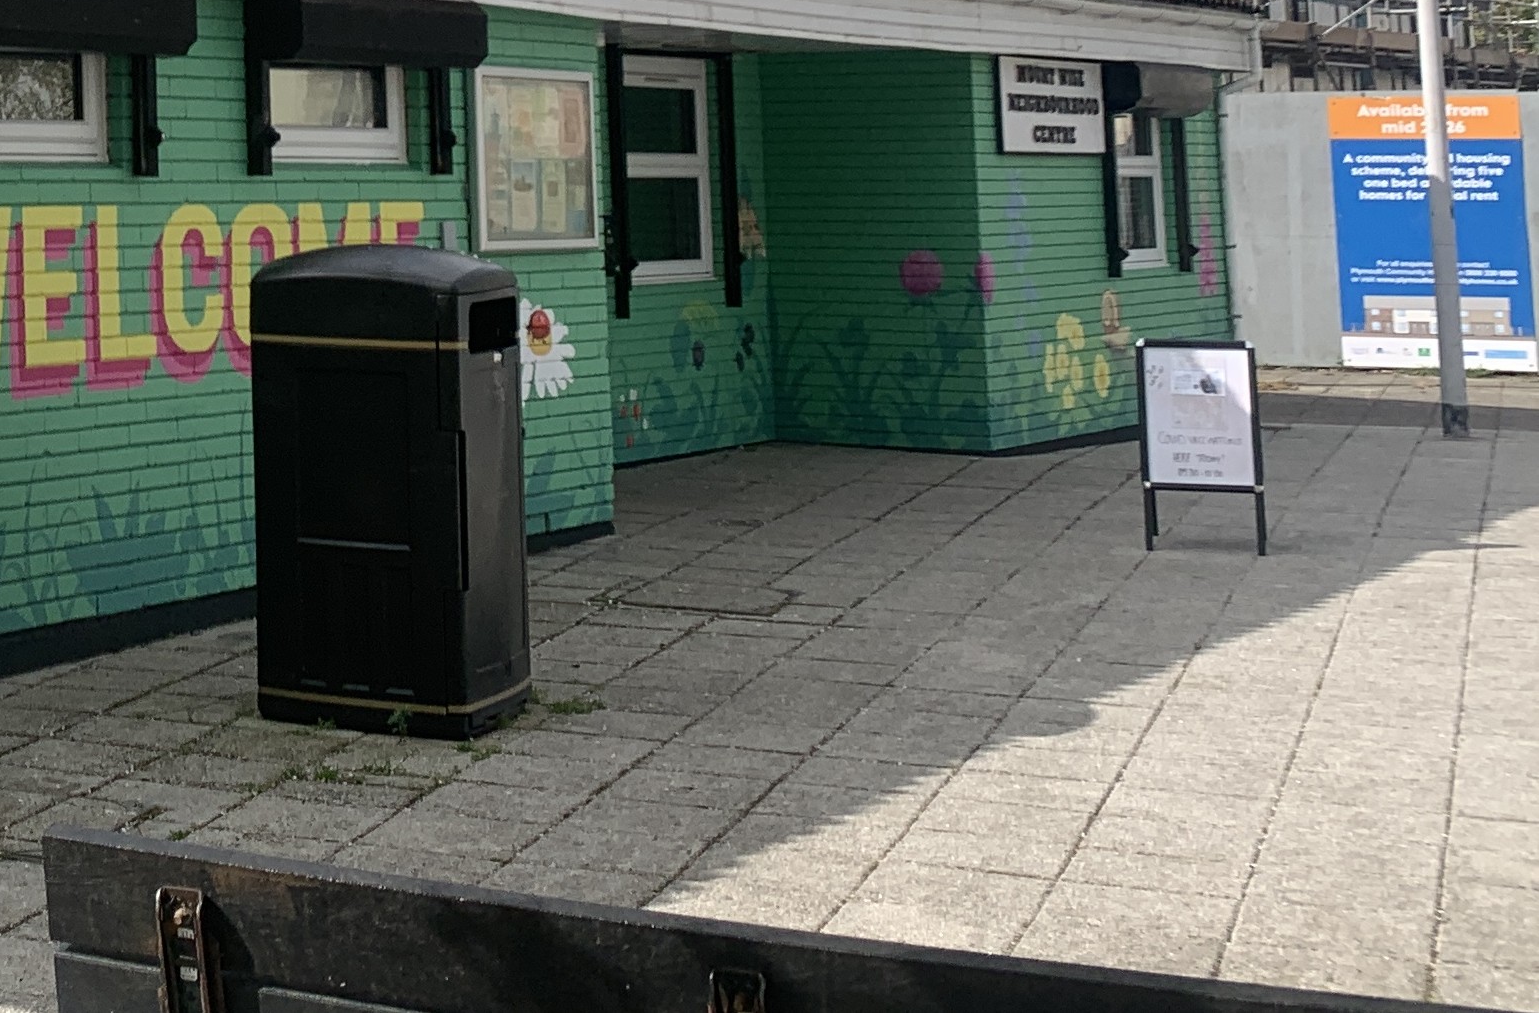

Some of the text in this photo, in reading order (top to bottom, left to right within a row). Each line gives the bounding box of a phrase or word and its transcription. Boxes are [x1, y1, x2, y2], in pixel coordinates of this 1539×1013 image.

[1357, 104, 1489, 117] Availab from
[1033, 125, 1077, 143] CENTRE
[1381, 121, 1466, 134] mid 226
[1342, 153, 1354, 164] A
[1456, 153, 1511, 167] housing
[1350, 166, 1406, 177] scheme,
[1477, 166, 1504, 177] five
[1363, 178, 1493, 190] one bed adable
[1359, 189, 1404, 201] homes
[1405, 189, 1427, 201] for
[1470, 190, 1499, 202] rent
